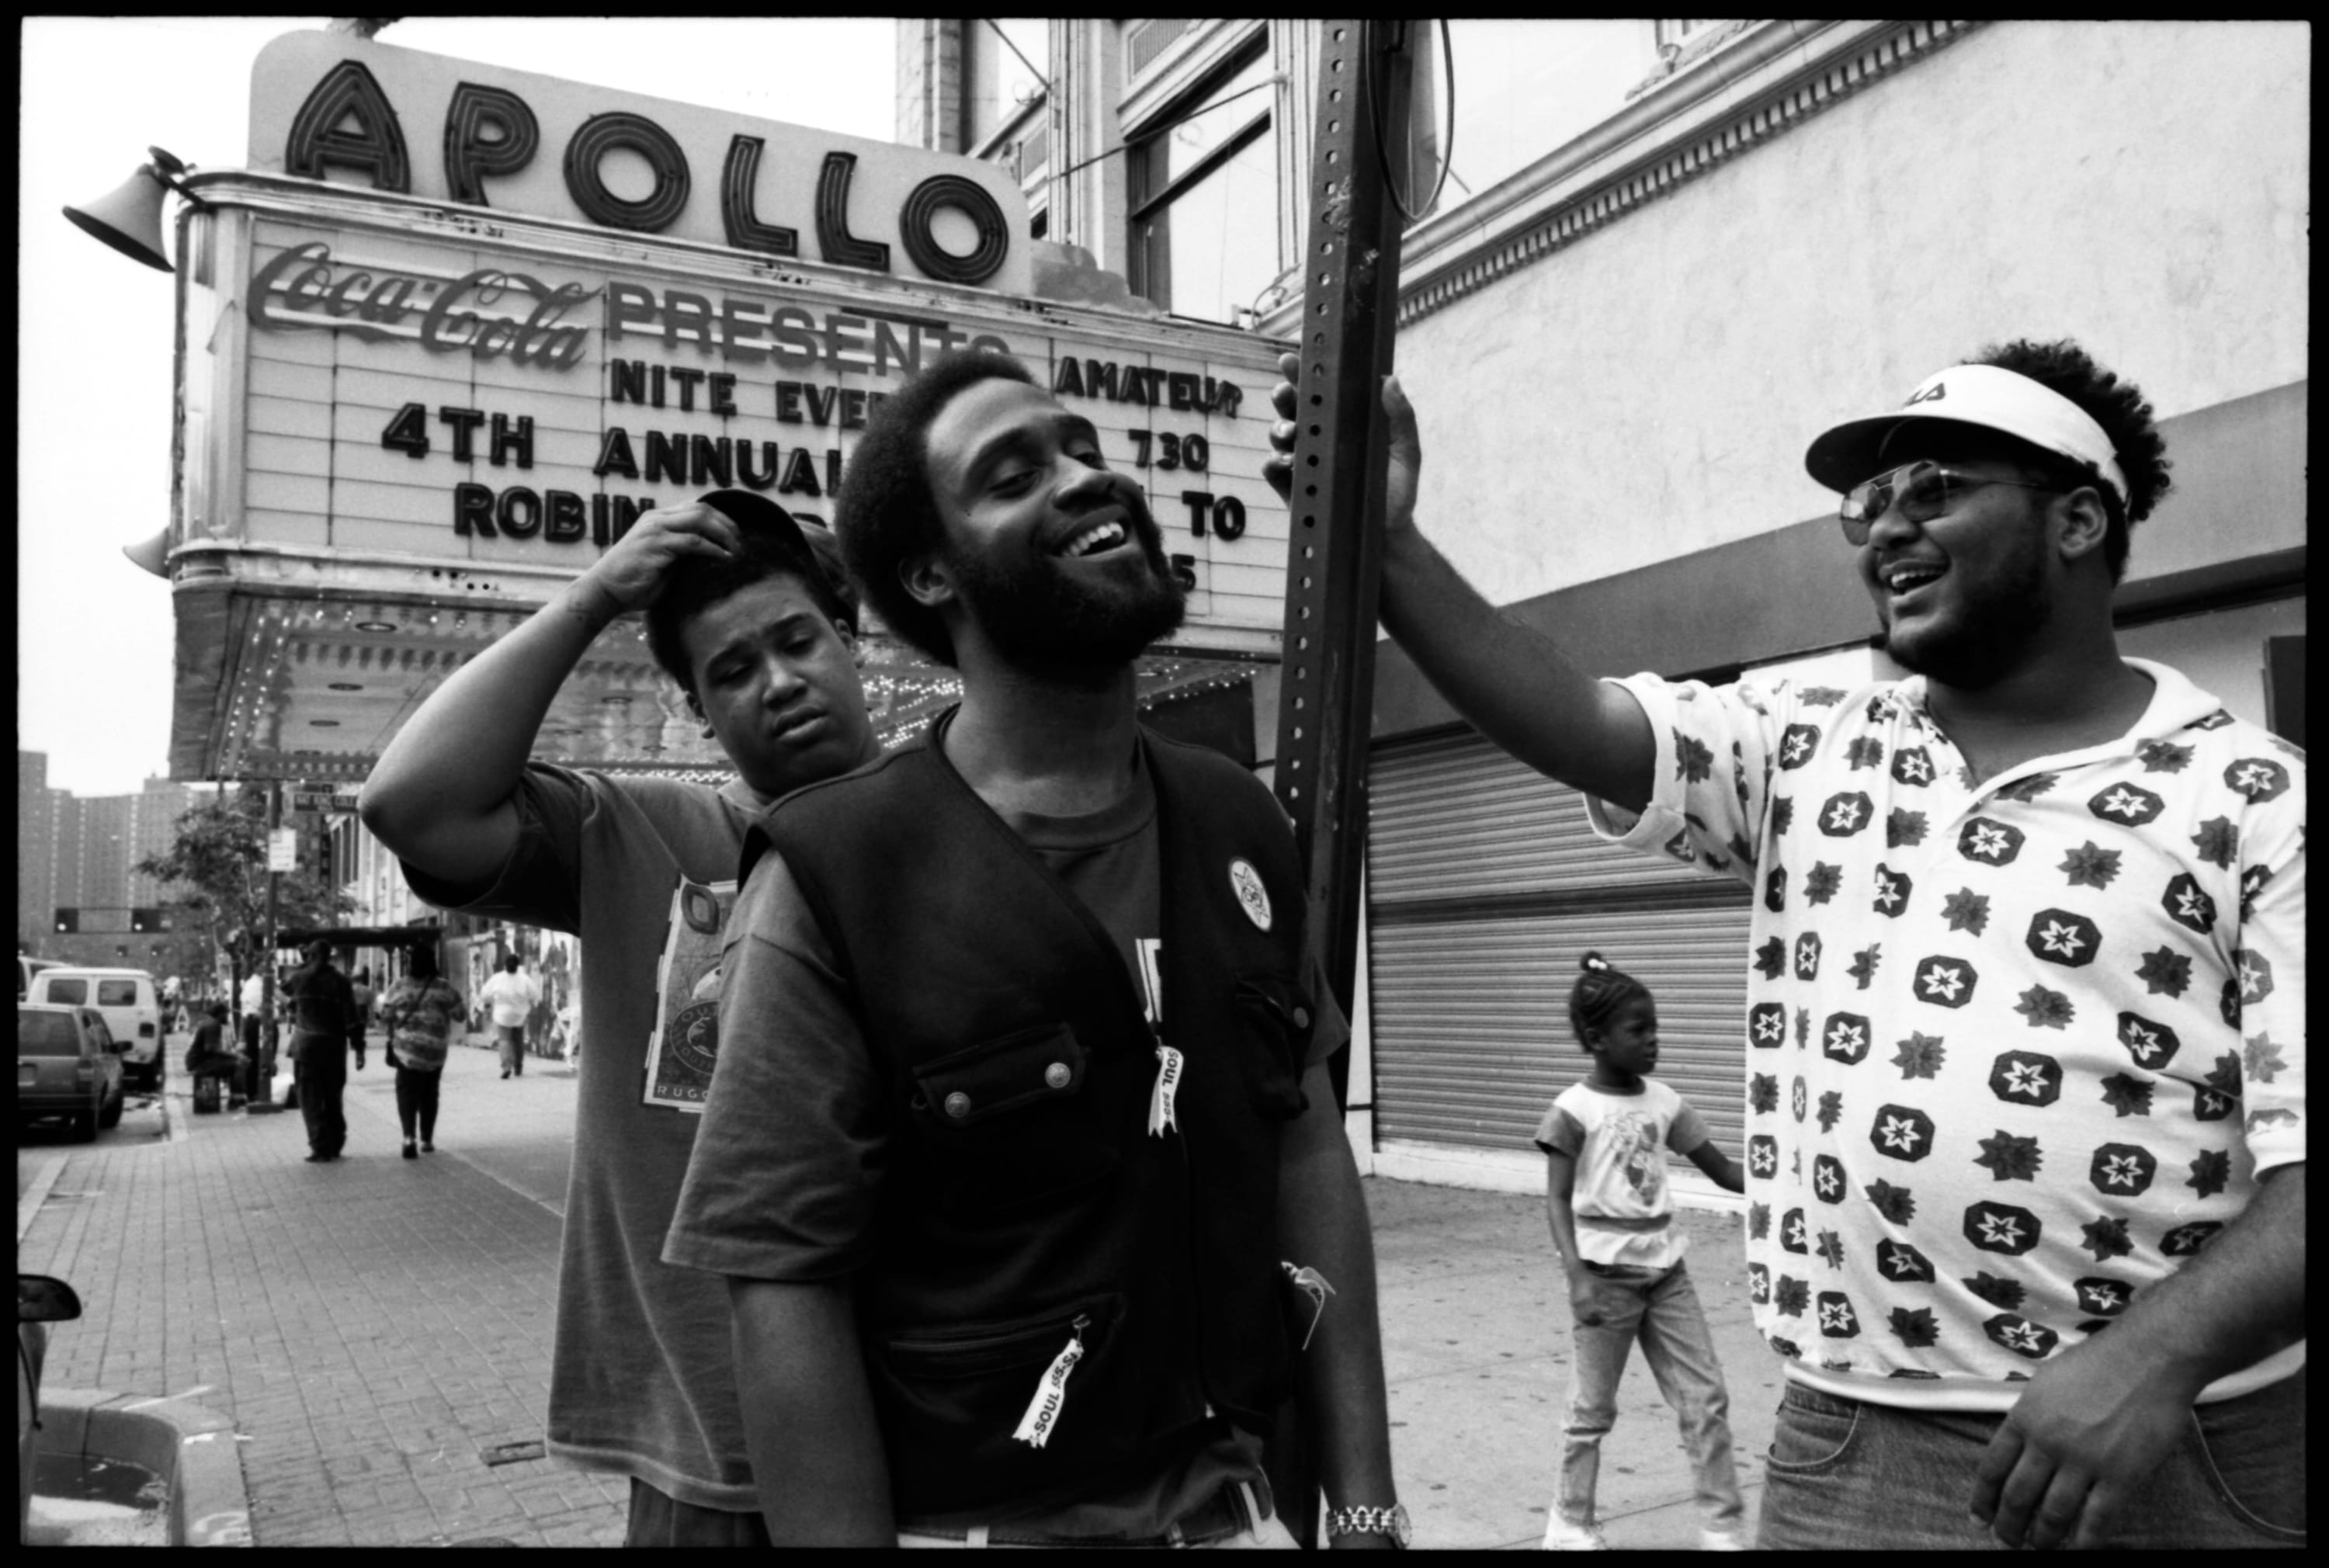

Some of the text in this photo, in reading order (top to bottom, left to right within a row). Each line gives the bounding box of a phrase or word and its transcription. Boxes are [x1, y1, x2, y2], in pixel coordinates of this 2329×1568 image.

[286, 59, 1008, 285] APOLLO
[246, 241, 606, 372] Coca-Cola
[1056, 356, 1242, 419] AMATEUR
[381, 403, 534, 469] 4TH
[1182, 490, 1247, 542] TO
[611, 358, 737, 416] NITE
[1128, 428, 1209, 471] 730
[1161, 1050, 1179, 1087] SOUL
